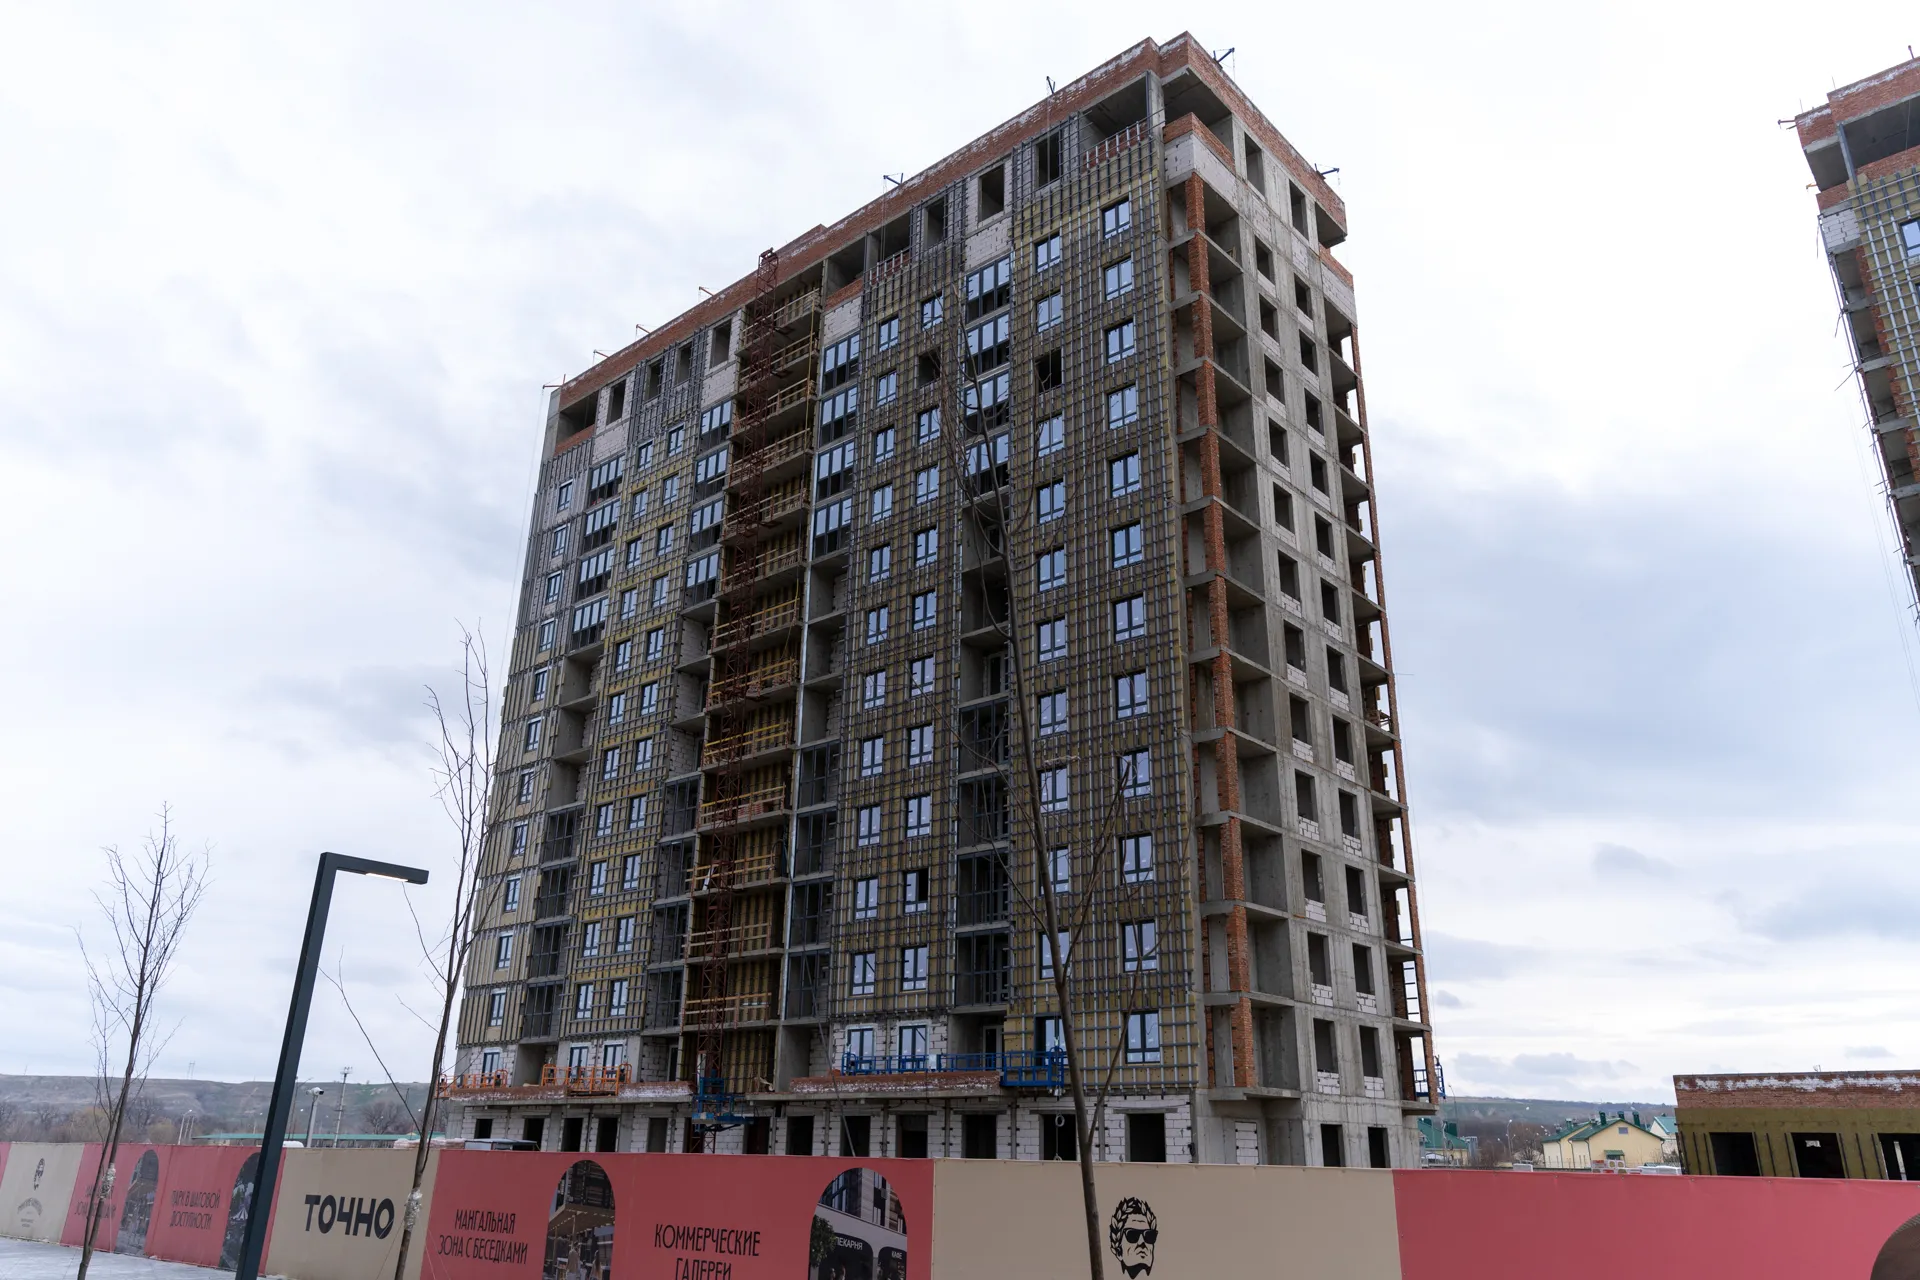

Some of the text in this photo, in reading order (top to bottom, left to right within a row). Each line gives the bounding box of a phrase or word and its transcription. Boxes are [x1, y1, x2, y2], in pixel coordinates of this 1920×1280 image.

[305, 1194, 394, 1239] ТОЧНО
[455, 1209, 516, 1234] МАНГАЛЬНАЯ
[438, 1234, 528, 1264] ЗОНА С БЕСЕДКАМИ
[654, 1223, 761, 1257] КОММЕРЧЕСКИЕ
